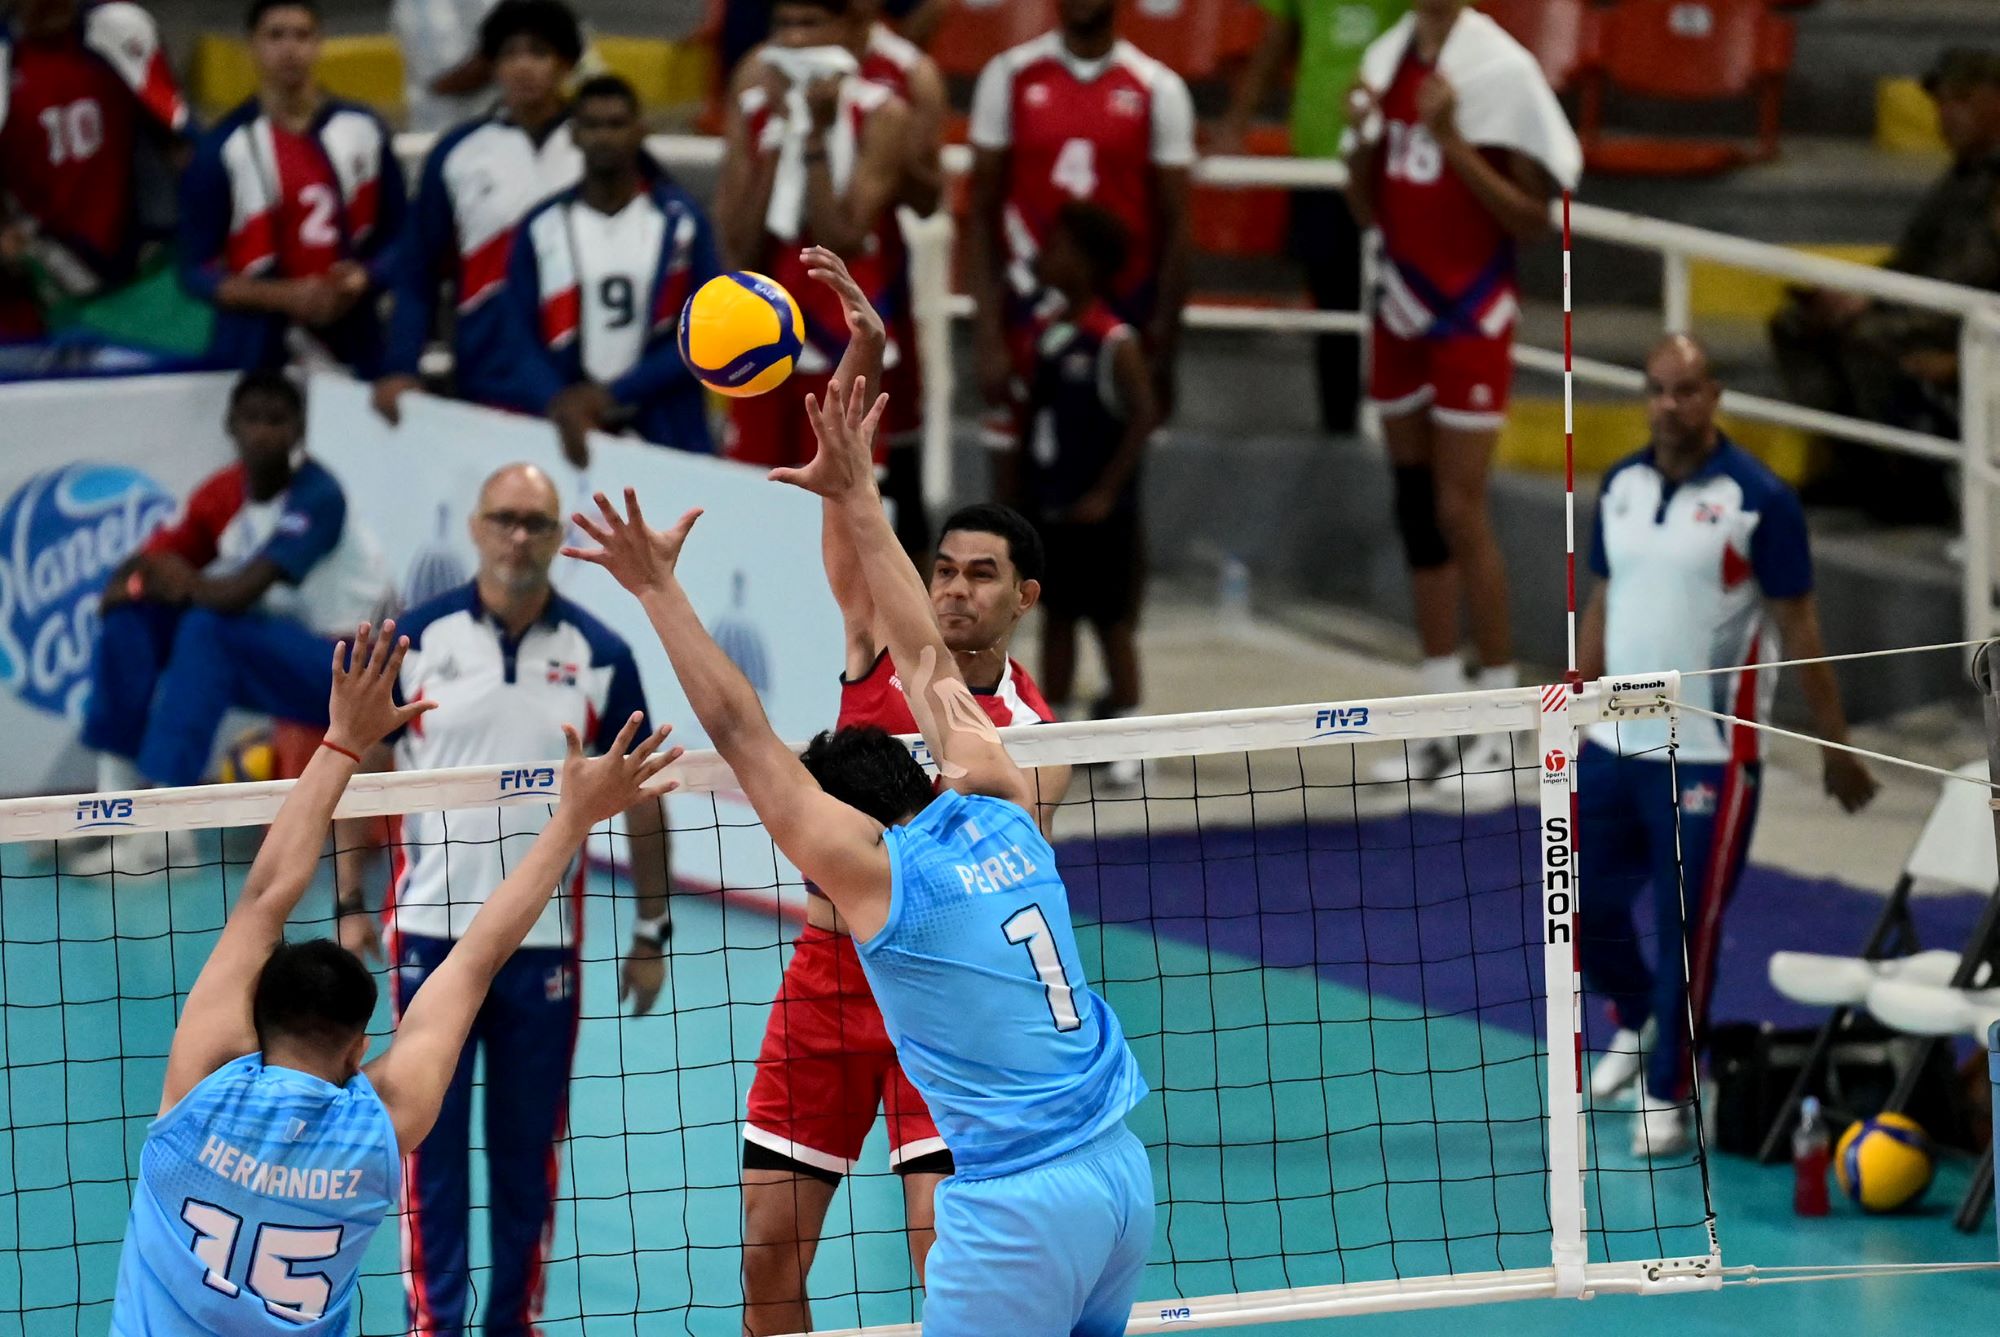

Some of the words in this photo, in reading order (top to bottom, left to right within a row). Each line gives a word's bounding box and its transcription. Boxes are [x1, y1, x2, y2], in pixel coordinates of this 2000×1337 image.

[39, 99, 104, 166] 10
[1051, 137, 1099, 199] 4
[297, 184, 337, 246] 2
[600, 274, 635, 329] 9
[1621, 680, 1665, 691] Senoh
[1316, 707, 1369, 729] FIVB
[500, 767, 555, 790] FIVB
[76, 798, 133, 820] FIVB
[955, 844, 1037, 895] PEREZ
[1000, 902, 1082, 1033] 1
[198, 1134, 363, 1200] HERNANDEZ
[180, 1196, 345, 1327] 15
[1160, 1307, 1190, 1320] FIVB
